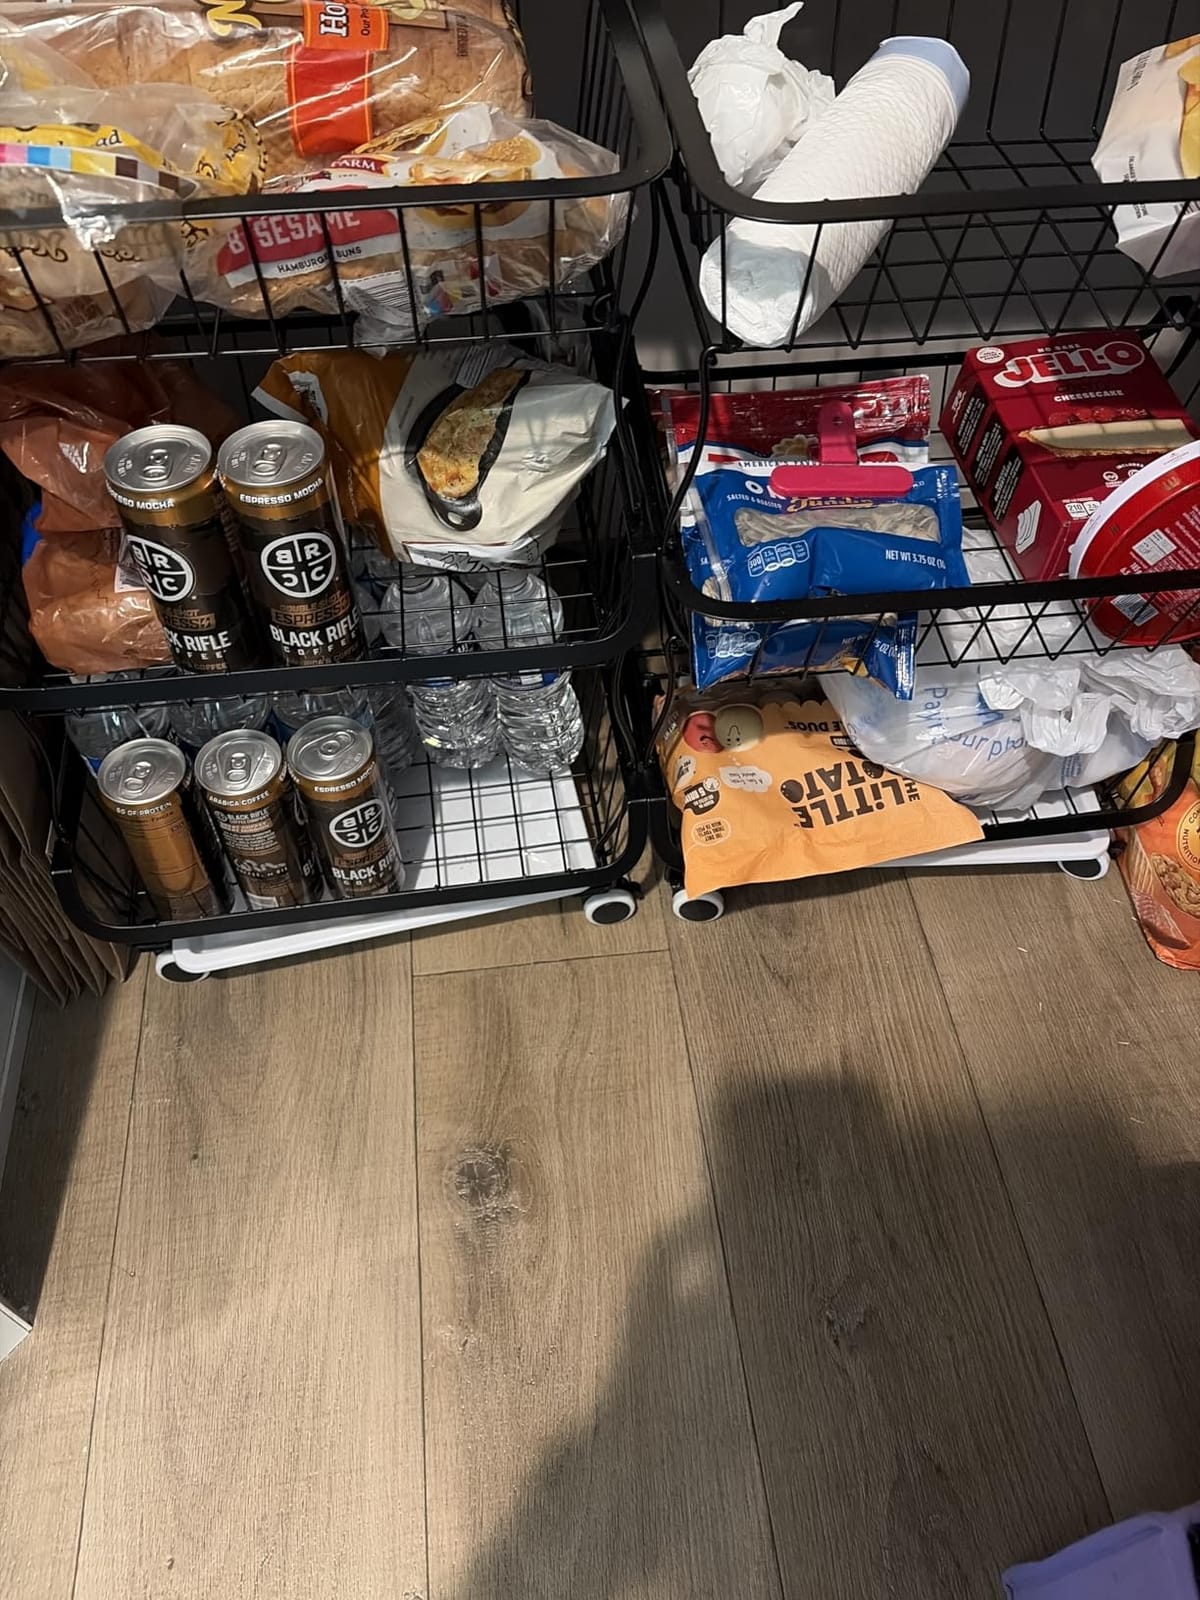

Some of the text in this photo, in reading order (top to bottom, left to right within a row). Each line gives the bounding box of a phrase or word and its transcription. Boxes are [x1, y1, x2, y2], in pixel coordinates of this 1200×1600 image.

[228, 229, 245, 254] 8
[336, 246, 362, 259] BUNS
[1053, 389, 1125, 403] CHEESECAKE
[239, 477, 324, 506] ESPRESSO MOCHA
[136, 499, 176, 511] MOCHA
[726, 493, 750, 502] SALTED
[756, 498, 783, 511] ROASTED
[1068, 504, 1082, 512] 210
[749, 555, 762, 569] 300
[885, 549, 900, 562] NET
[900, 551, 912, 563] WT
[912, 552, 926, 566] 3.75
[269, 605, 361, 648] BLACK RIFLE
[182, 631, 232, 652] RIFLE
[283, 630, 357, 656] COFFEE
[788, 720, 829, 732] DUOS
[314, 781, 357, 794] ESPRESSO
[780, 758, 888, 804] OTATO
[902, 777, 921, 802] HE
[208, 790, 270, 807] ARABICA COFFEE
[127, 809, 138, 817] OF
[138, 802, 173, 817] PROTEIN
[227, 812, 251, 822] BLACK
[331, 864, 377, 882] BLACK
[378, 848, 398, 873] RIF
